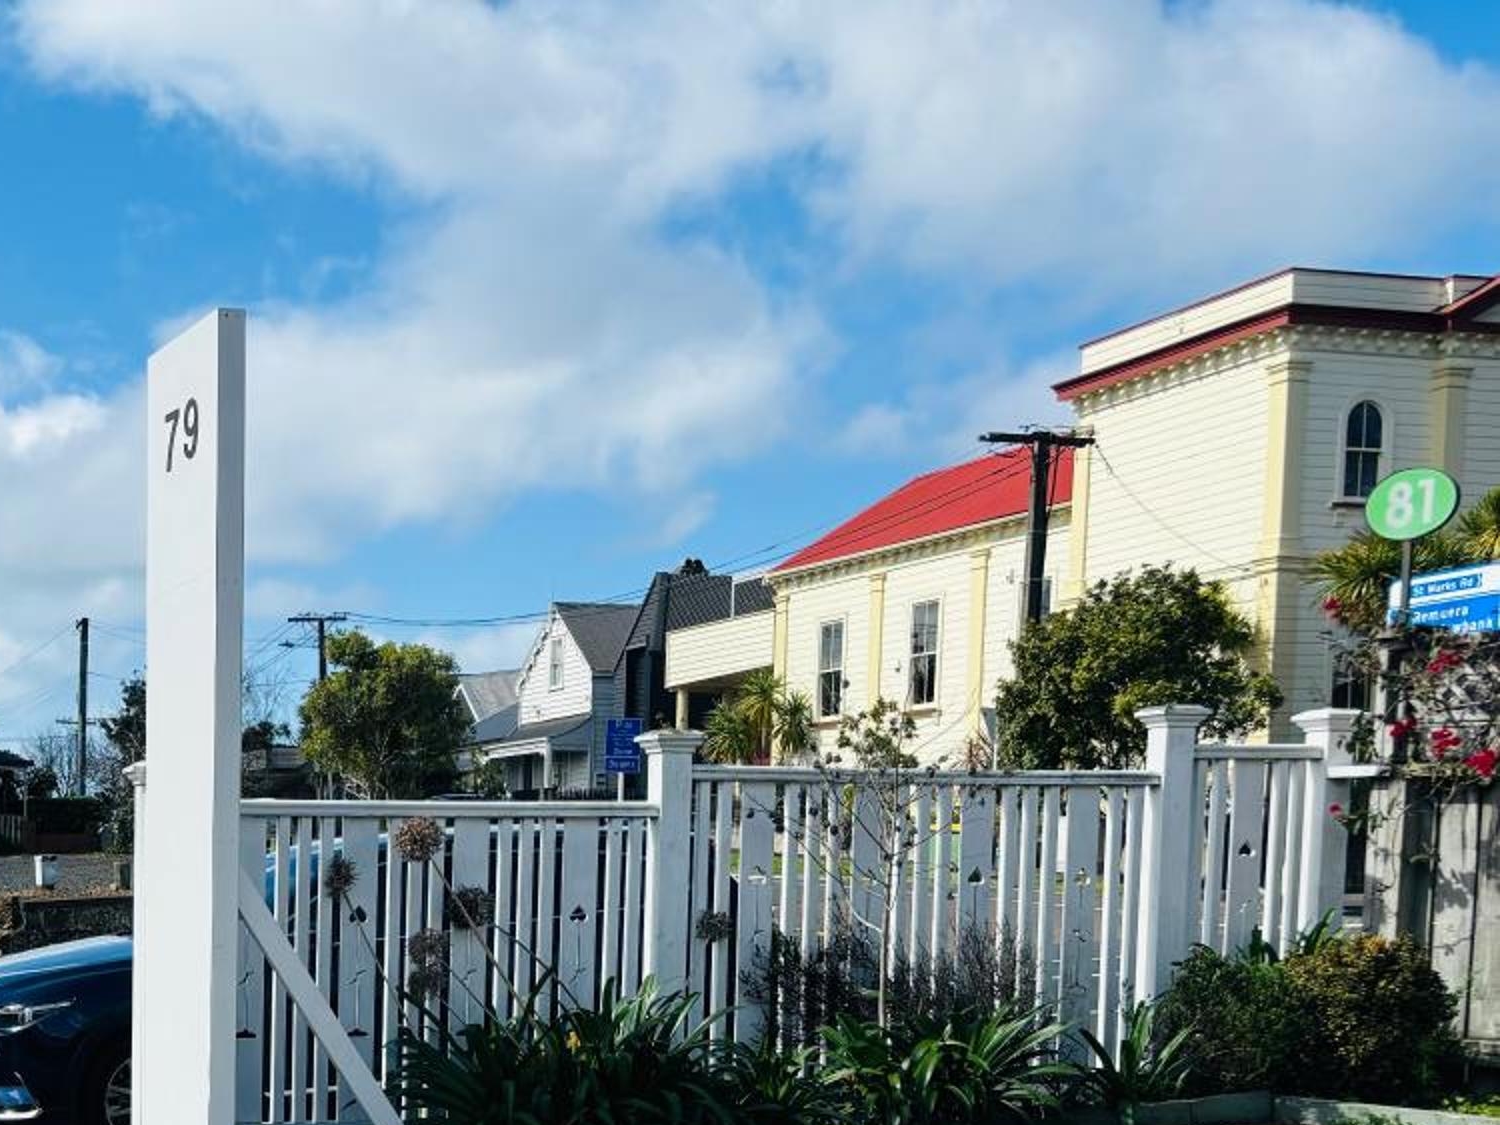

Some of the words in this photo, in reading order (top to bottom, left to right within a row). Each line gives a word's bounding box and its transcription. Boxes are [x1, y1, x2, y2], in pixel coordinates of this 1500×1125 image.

[164, 397, 199, 473] 79
[1385, 478, 1437, 529] 81
[1427, 581, 1457, 593] Marks
[1459, 576, 1474, 589] Rd
[1411, 605, 1470, 624] Remuera
